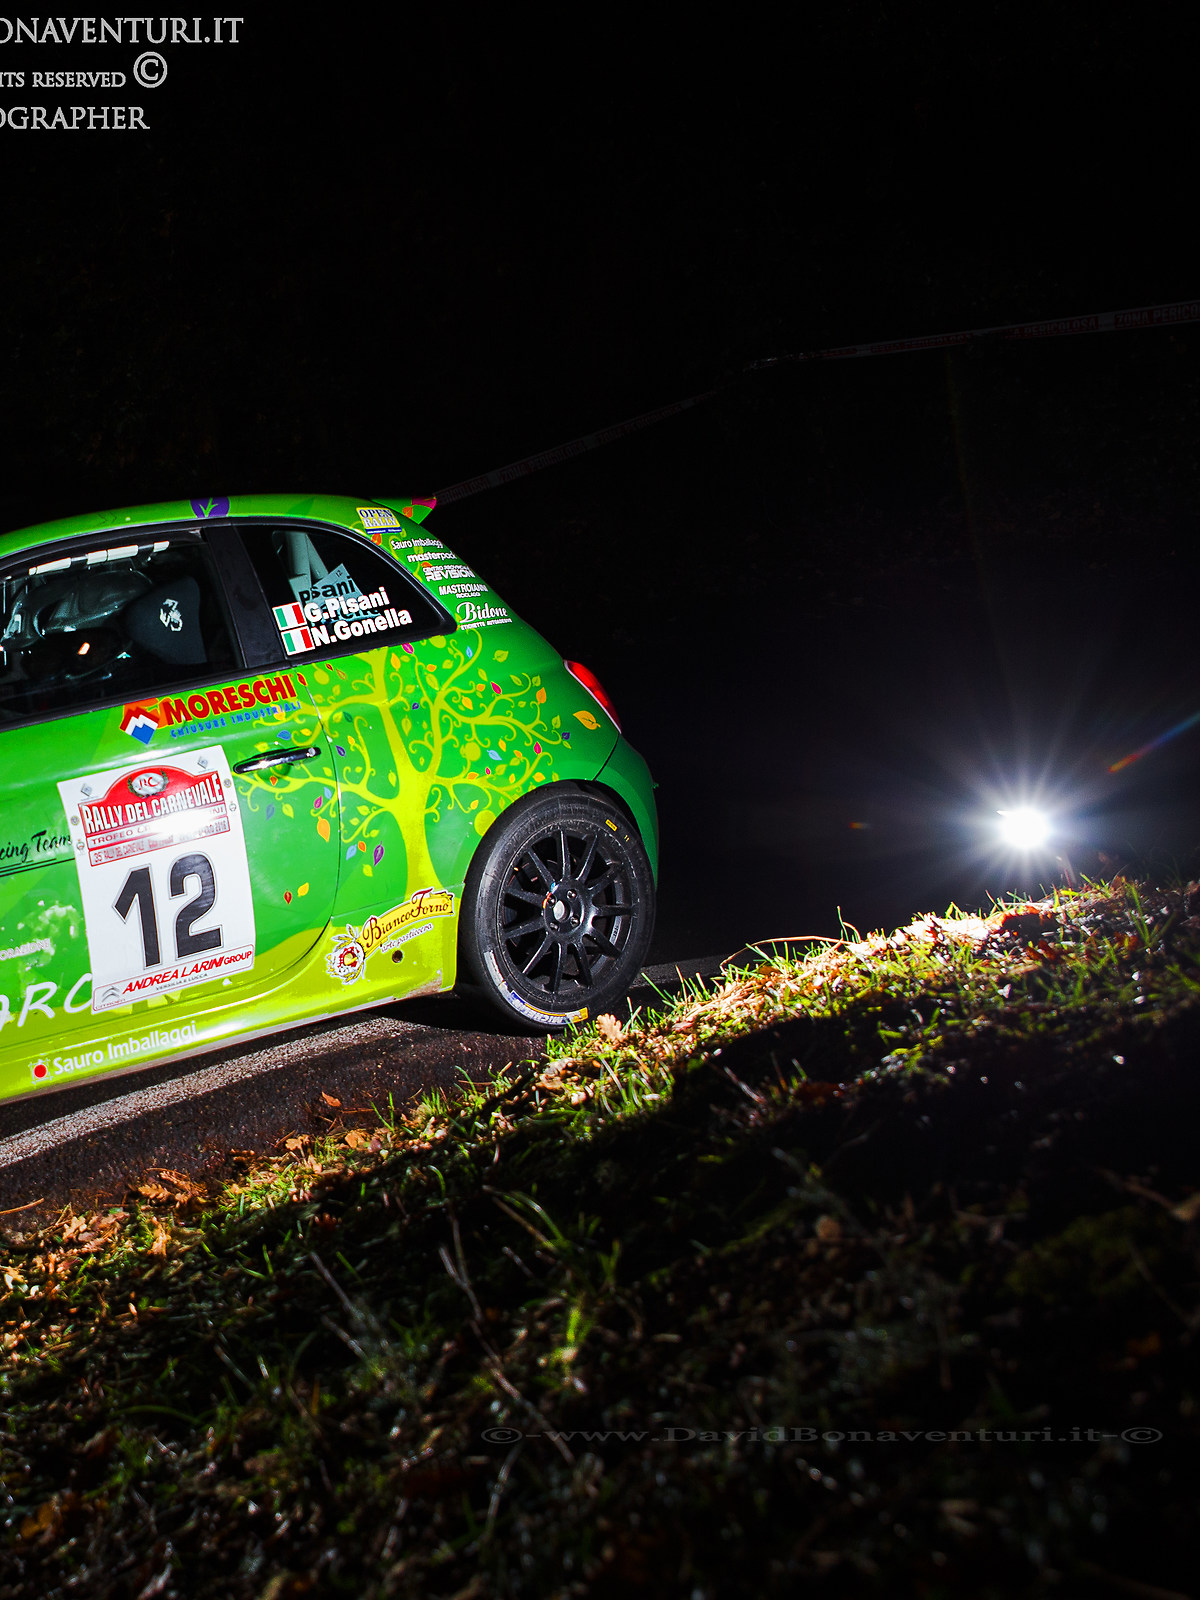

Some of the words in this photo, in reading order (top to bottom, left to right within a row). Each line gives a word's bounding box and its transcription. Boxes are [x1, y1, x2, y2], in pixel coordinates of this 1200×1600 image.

[359, 509, 394, 518] OPEN
[362, 517, 398, 528] RALLY
[391, 540, 412, 550] Sauro
[304, 586, 390, 622] G.Pisani
[457, 602, 508, 623] Bidone
[311, 607, 413, 647] N.Gonella
[164, 674, 297, 726] MORESCHI
[170, 717, 227, 738] CHIUSURE
[231, 701, 302, 725] INDUSTRIALI
[80, 805, 124, 834] RALLY
[125, 802, 152, 824] DEL
[151, 773, 224, 816] CARNEVALE
[30, 829, 71, 852] Team
[113, 852, 222, 969] 12
[122, 968, 179, 994] ANDREA
[180, 956, 225, 978] LARINI
[224, 950, 252, 966] GROUP
[53, 1049, 104, 1075] Sauro
[108, 1020, 197, 1060] Imballaggi
